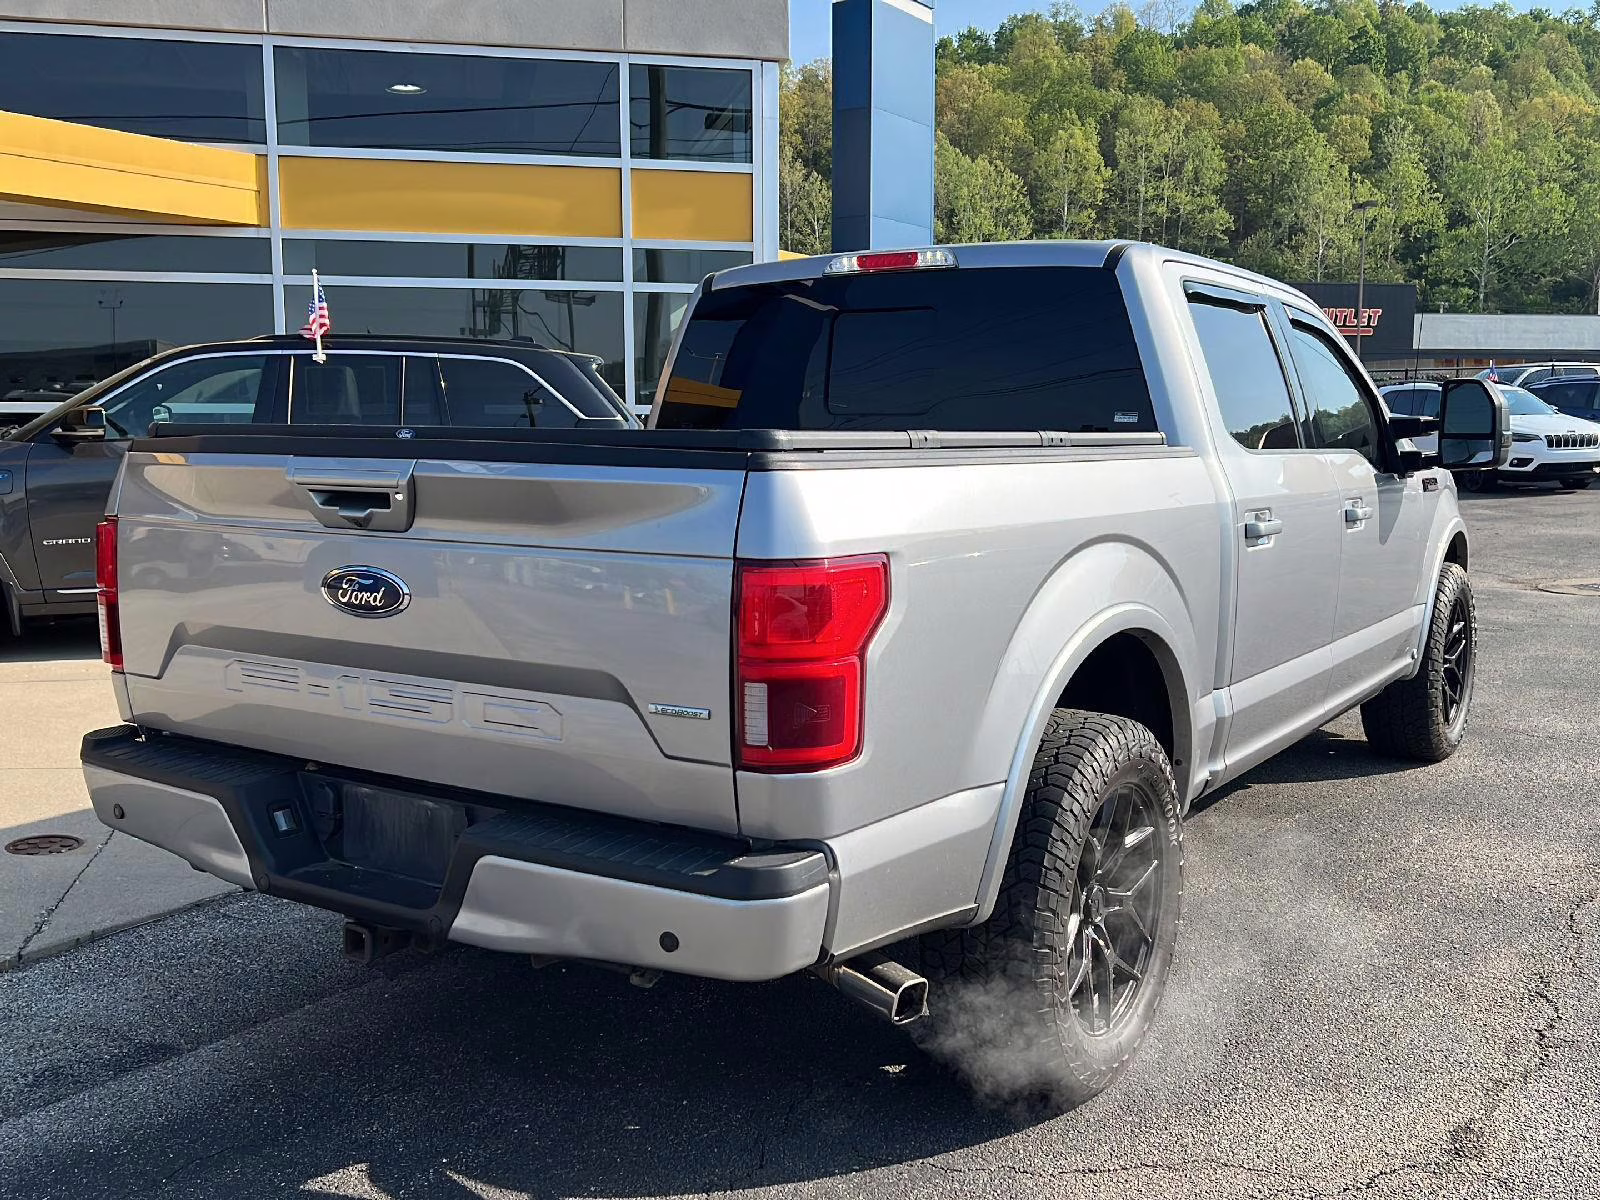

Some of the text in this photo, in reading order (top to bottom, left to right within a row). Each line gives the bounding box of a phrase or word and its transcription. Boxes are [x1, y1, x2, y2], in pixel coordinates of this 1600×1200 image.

[42, 537, 91, 545] GRAND
[338, 576, 385, 606] Ford
[224, 658, 563, 742] F-150
